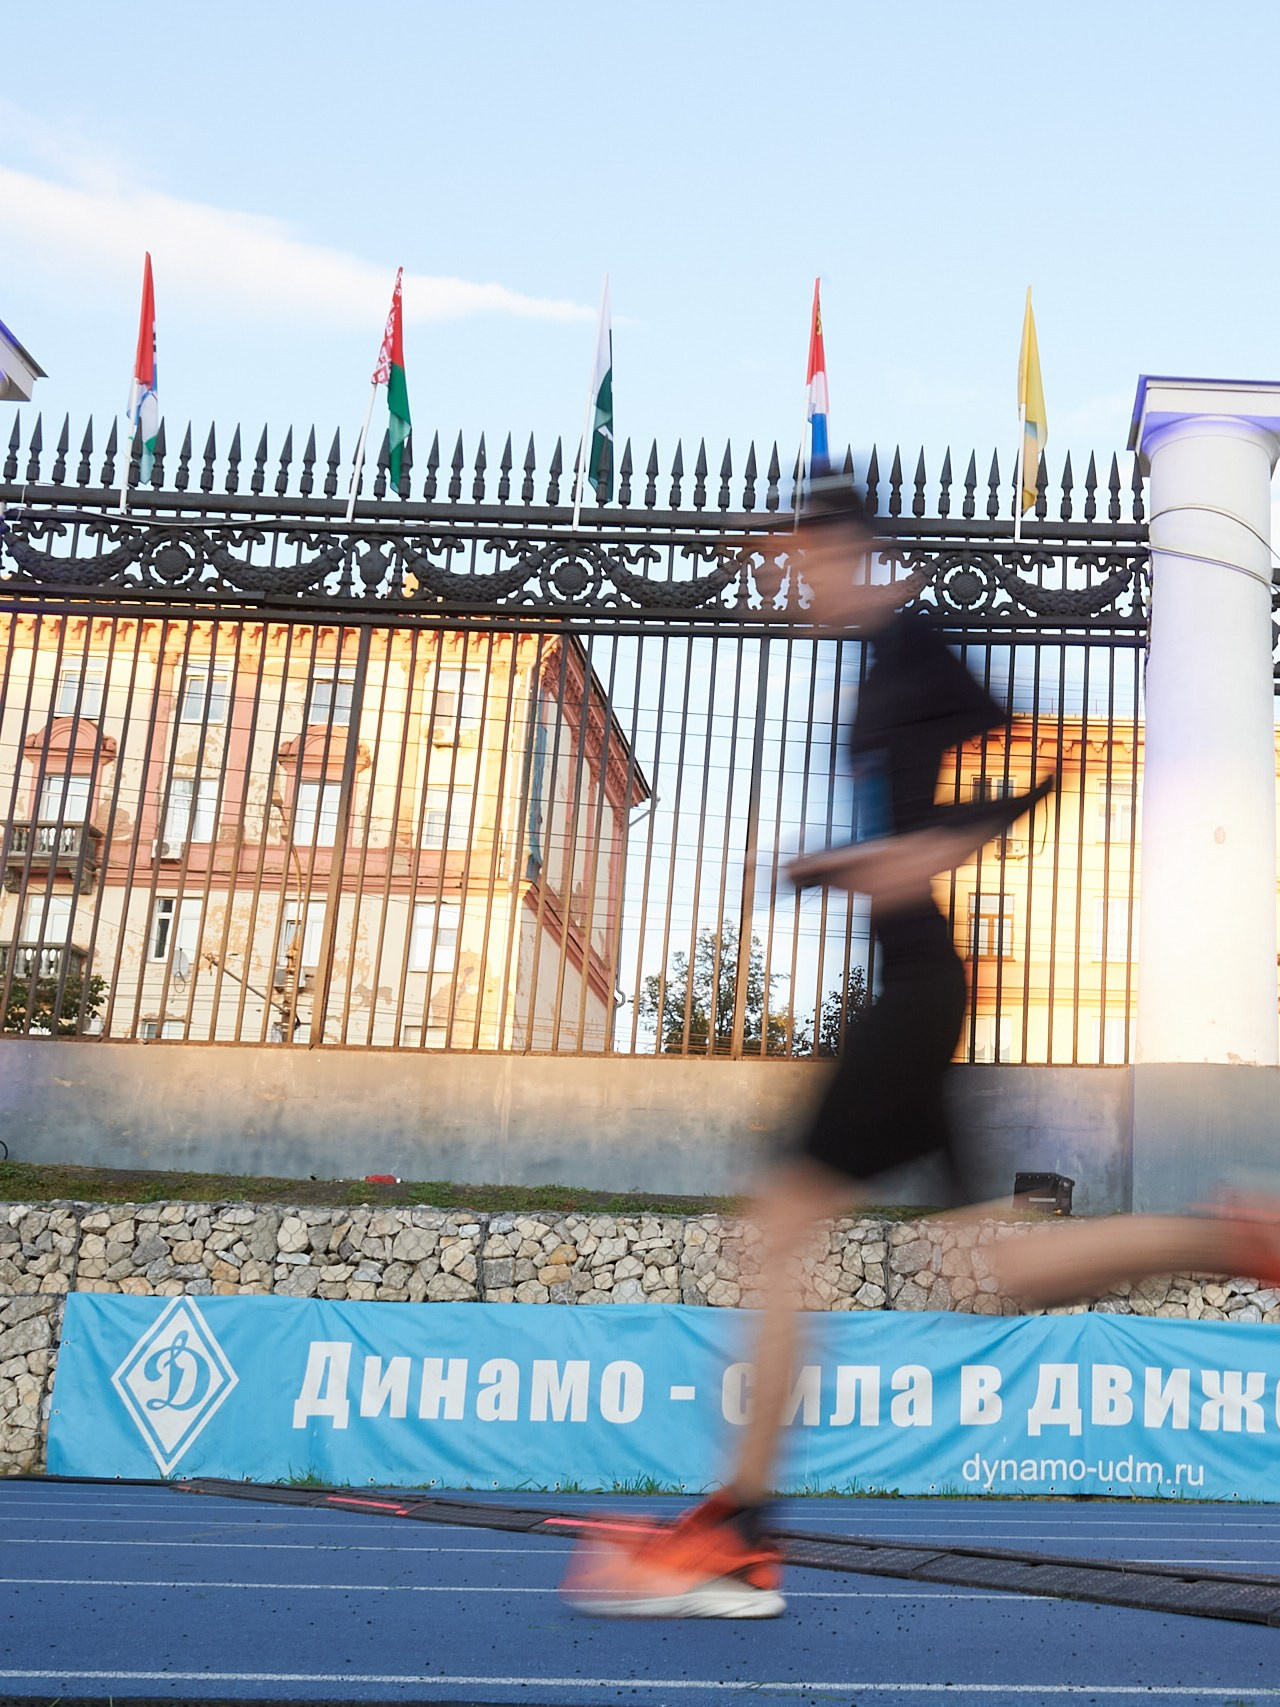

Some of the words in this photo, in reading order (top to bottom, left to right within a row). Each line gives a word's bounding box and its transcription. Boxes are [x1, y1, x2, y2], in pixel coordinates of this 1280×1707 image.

[292, 1341, 645, 1430] Динамо
[670, 1385, 696, 1400] -
[960, 1365, 1002, 1427] в
[962, 1453, 1204, 1489] dynamo-udm.ru
